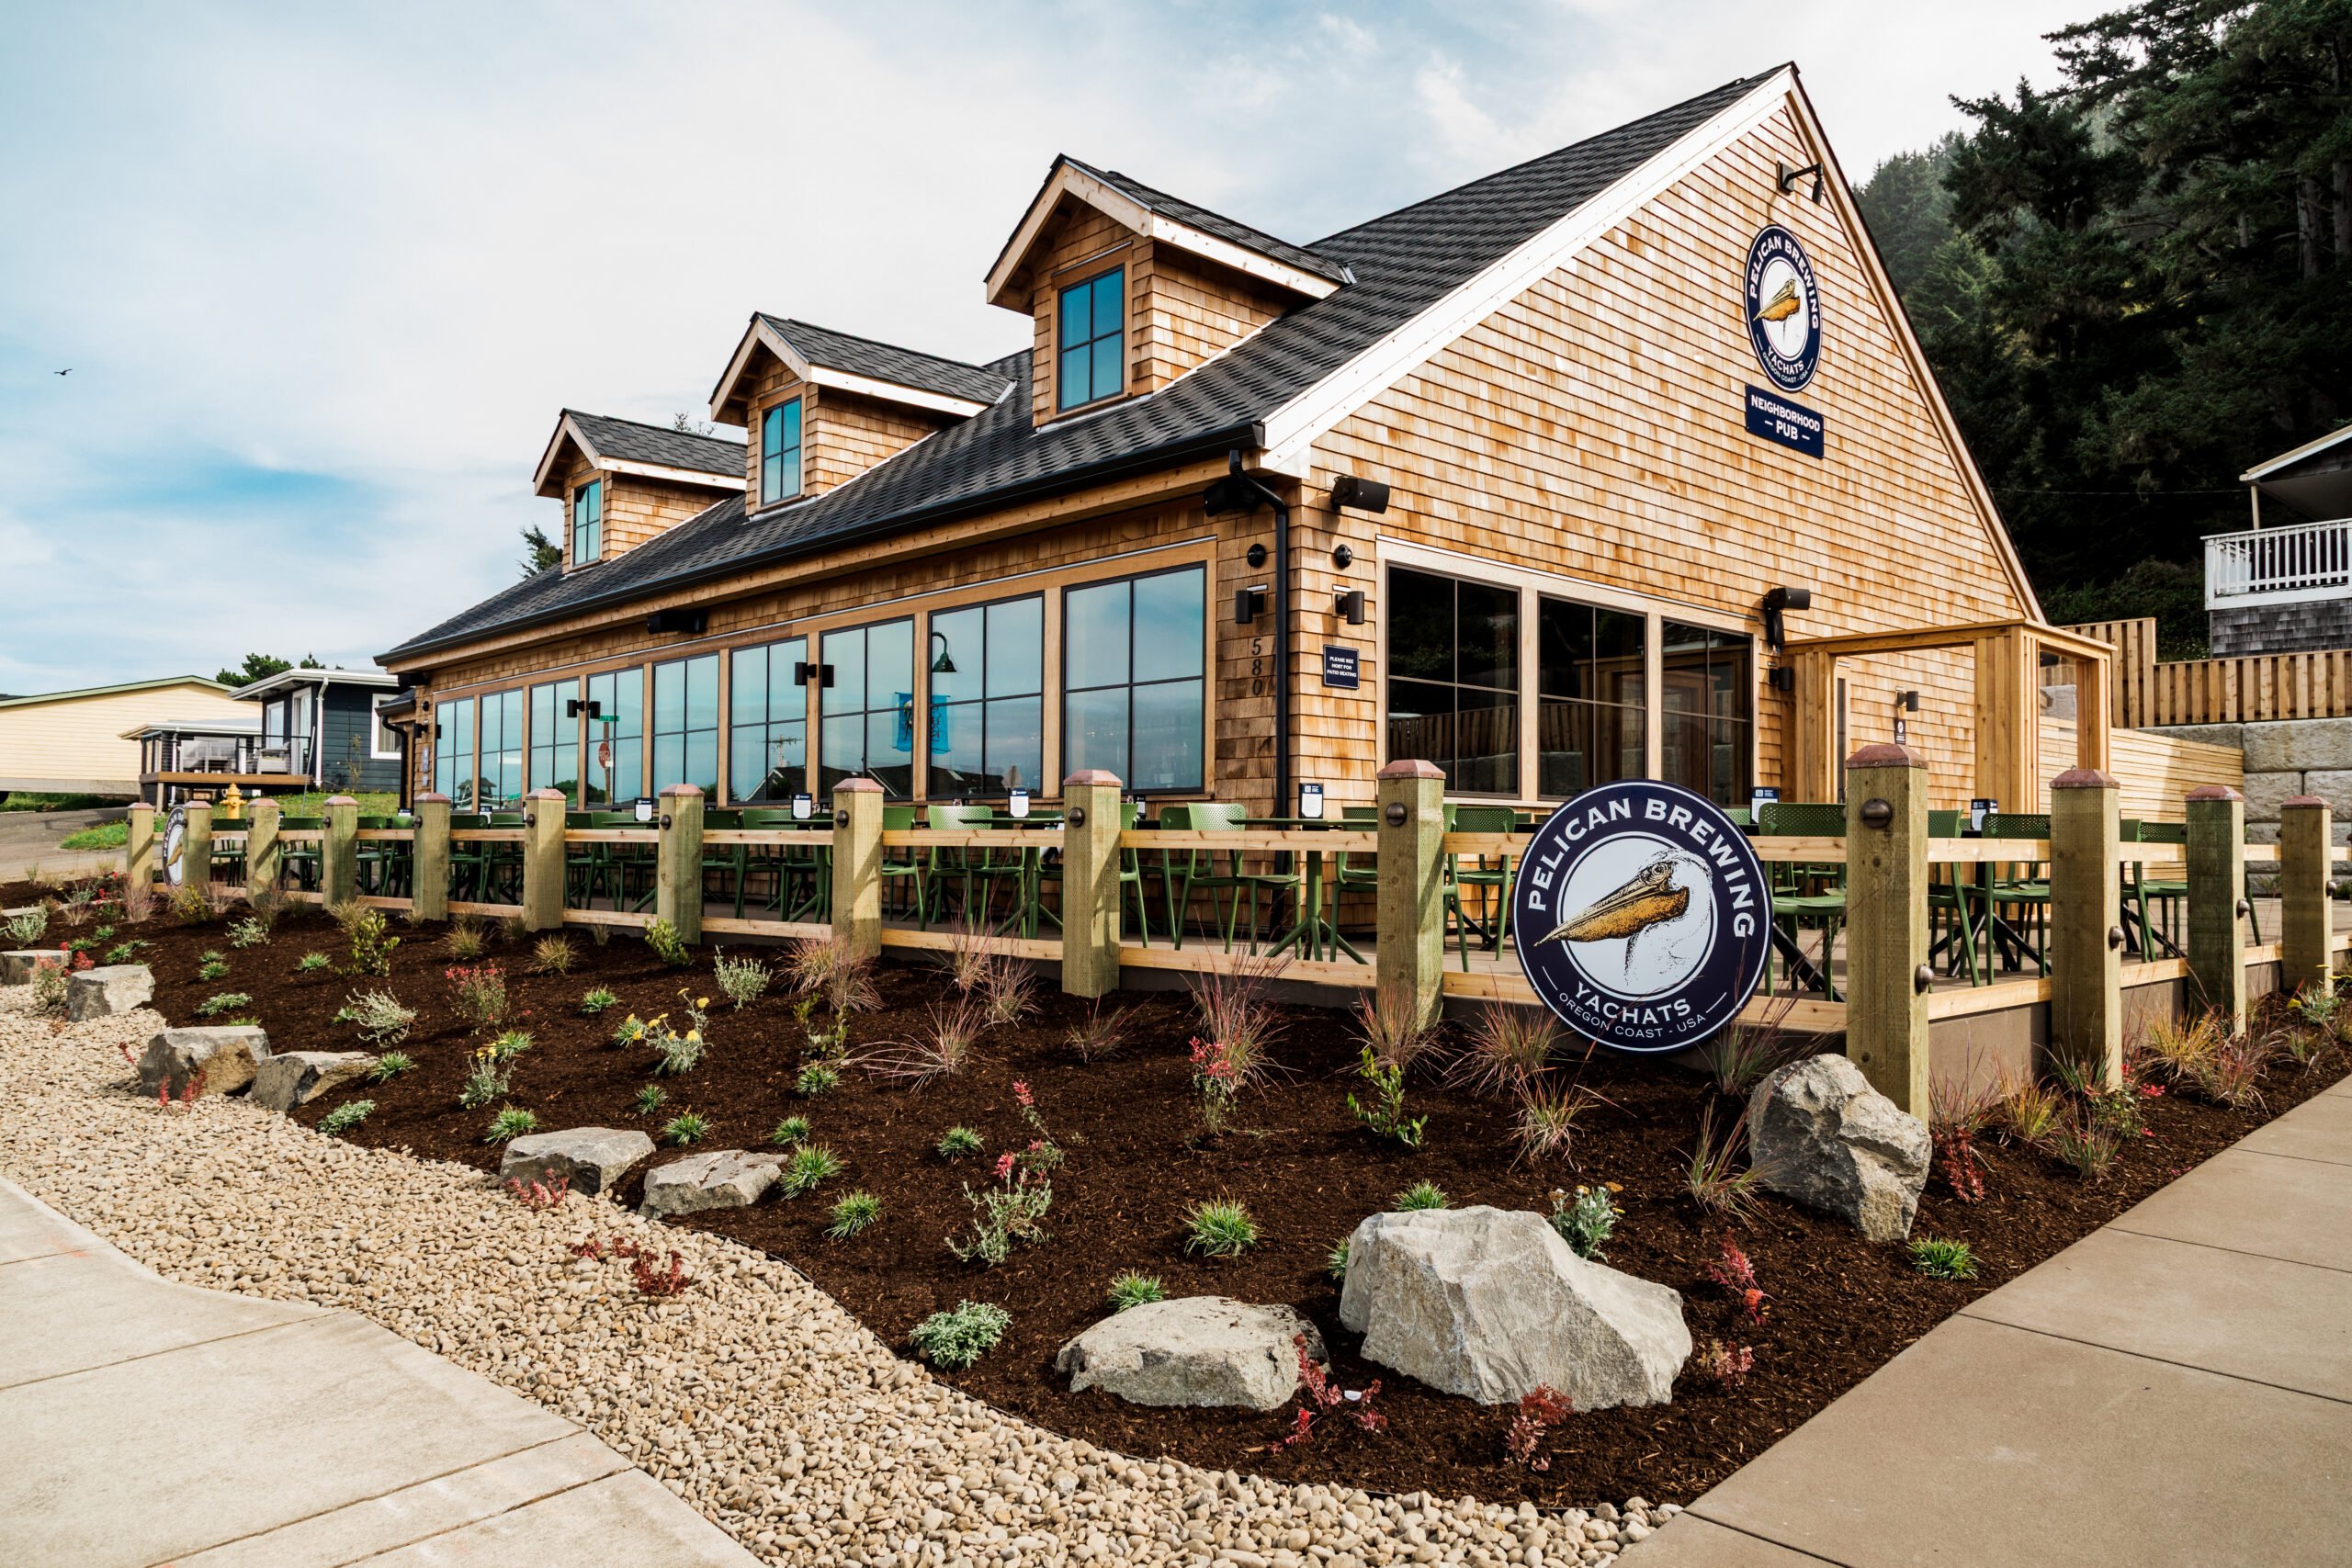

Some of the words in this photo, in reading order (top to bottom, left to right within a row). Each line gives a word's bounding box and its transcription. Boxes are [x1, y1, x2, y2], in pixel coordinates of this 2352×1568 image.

[1749, 235, 1781, 299] PELICAN
[1784, 239, 1819, 330] BREWING
[1762, 352, 1781, 378] OREGON
[1781, 374, 1797, 384] COAST
[1799, 370, 1809, 380] USA
[1768, 345, 1804, 376] YACHATS
[1751, 394, 1821, 433] NEIGHBORHOOD
[1776, 420, 1798, 440] PUB
[1528, 797, 1632, 912] PELICAN
[1644, 797, 1756, 939] BREWING
[1559, 992, 1610, 1031] OREGON
[1614, 1025, 1664, 1039] COAST
[1677, 1013, 1707, 1033] USA
[1575, 981, 1691, 1025] YACHATS
